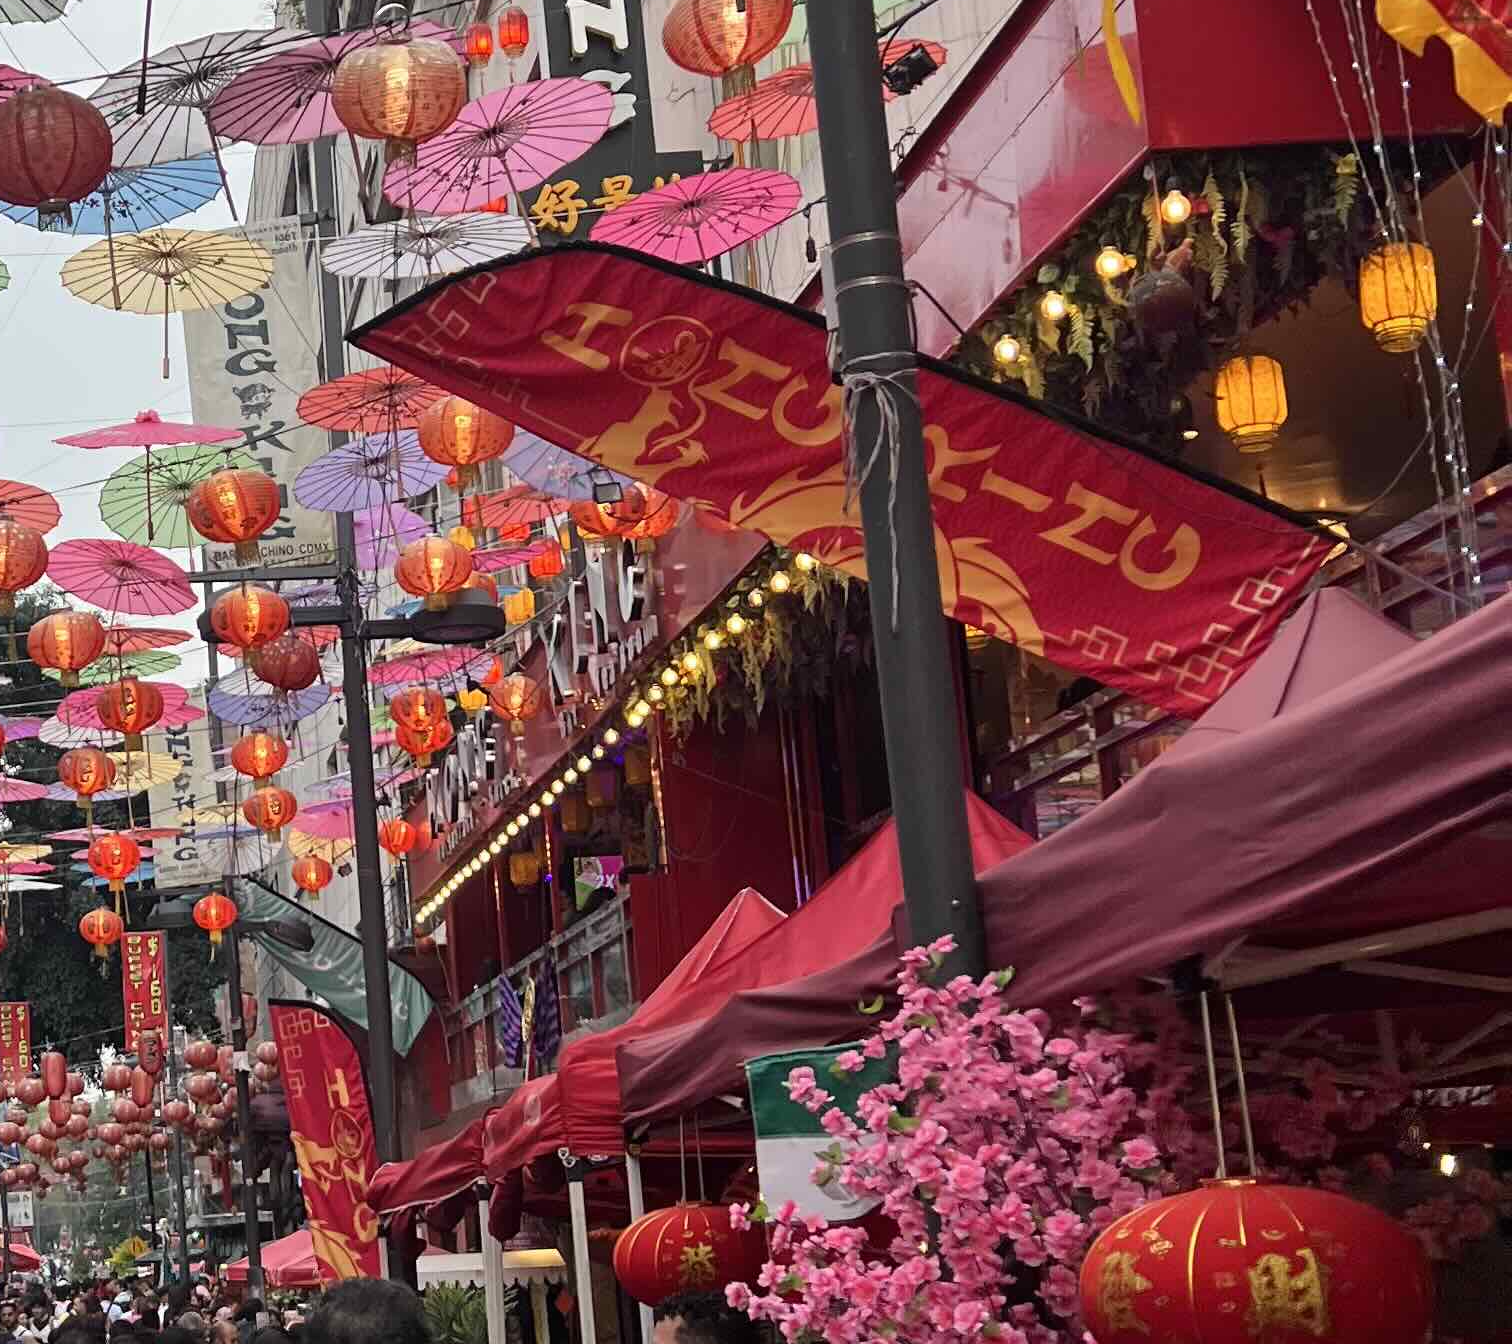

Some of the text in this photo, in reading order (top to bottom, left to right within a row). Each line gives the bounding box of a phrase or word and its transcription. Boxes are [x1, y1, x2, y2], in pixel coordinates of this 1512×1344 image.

[260, 544, 294, 558] CHINO
[298, 542, 330, 555] CDMX
[127, 935, 145, 991] BUFFET
